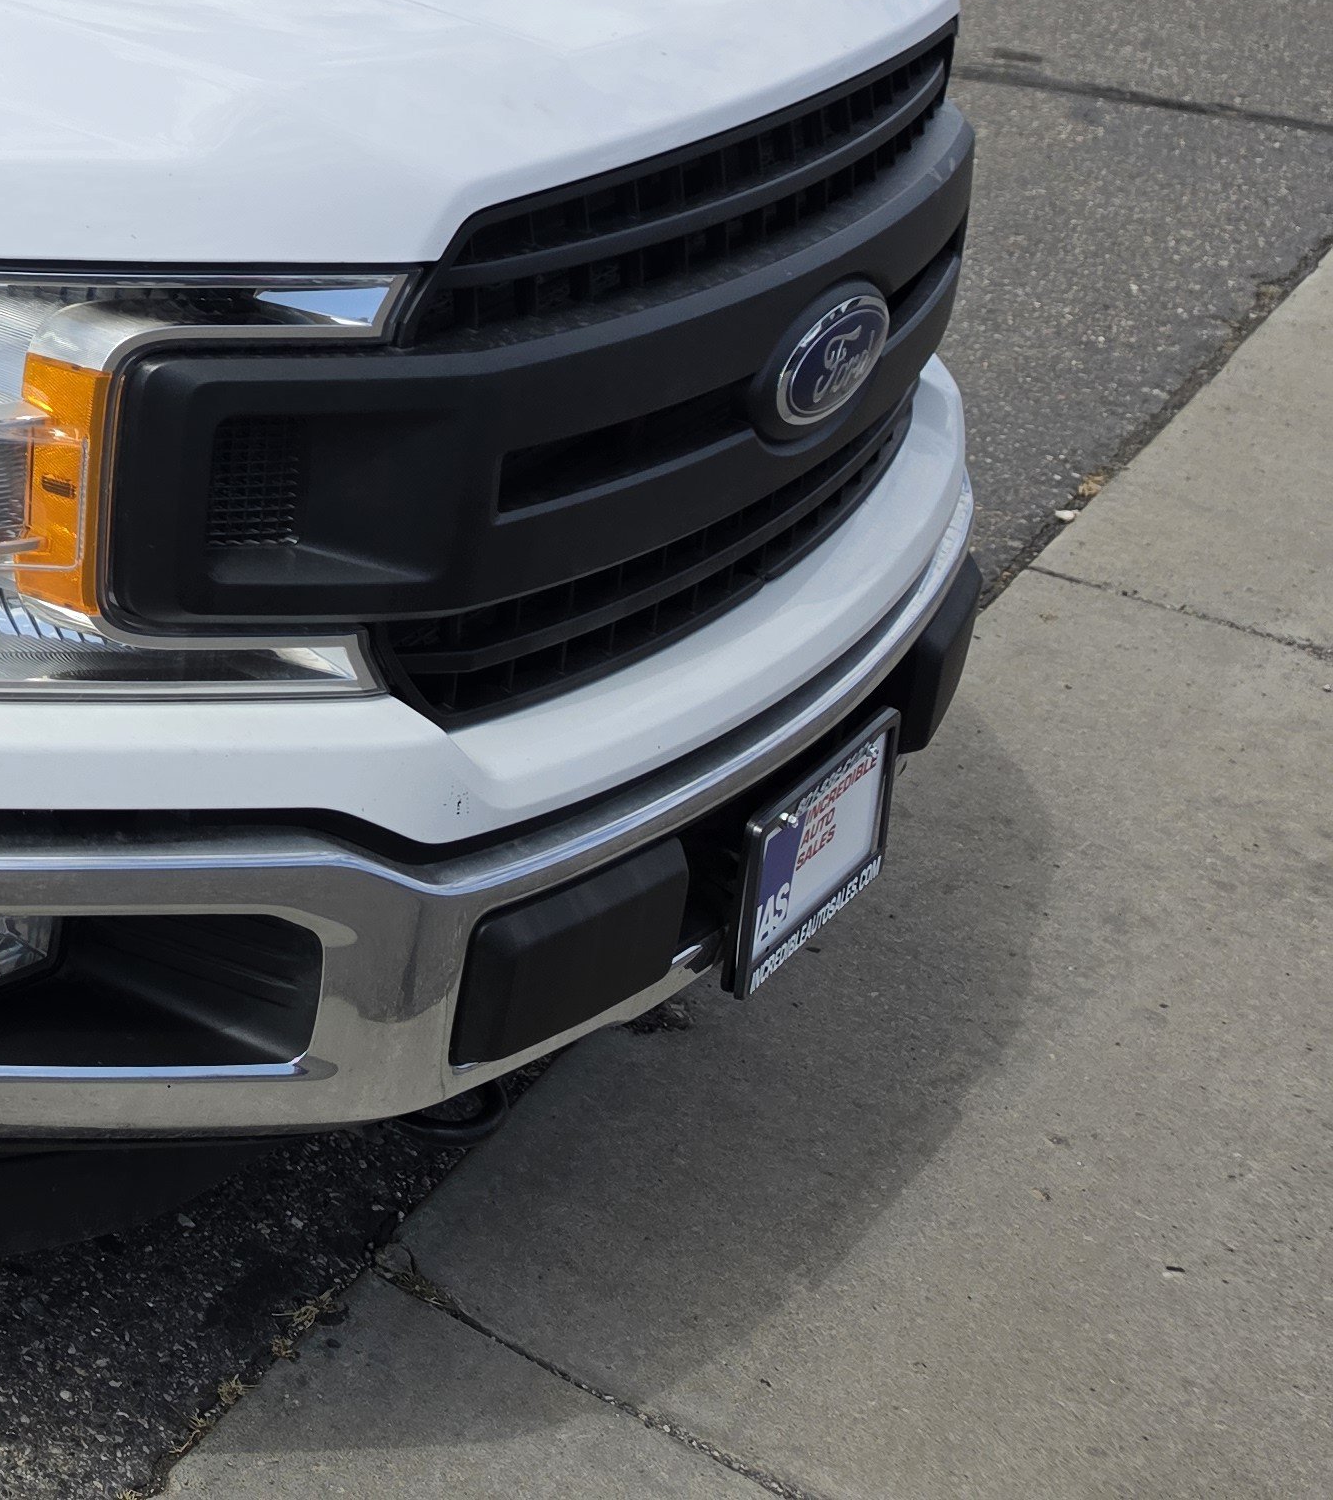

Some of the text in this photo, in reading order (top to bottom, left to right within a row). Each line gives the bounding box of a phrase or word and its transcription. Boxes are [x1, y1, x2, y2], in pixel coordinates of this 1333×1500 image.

[813, 325, 876, 403] Ford
[805, 757, 877, 826] INCREDIBLE
[795, 824, 836, 871] SALES
[800, 807, 836, 848] AUTO
[749, 855, 882, 995] INCREDIBLEAUTOSALES.COM
[753, 882, 790, 943] IAS
